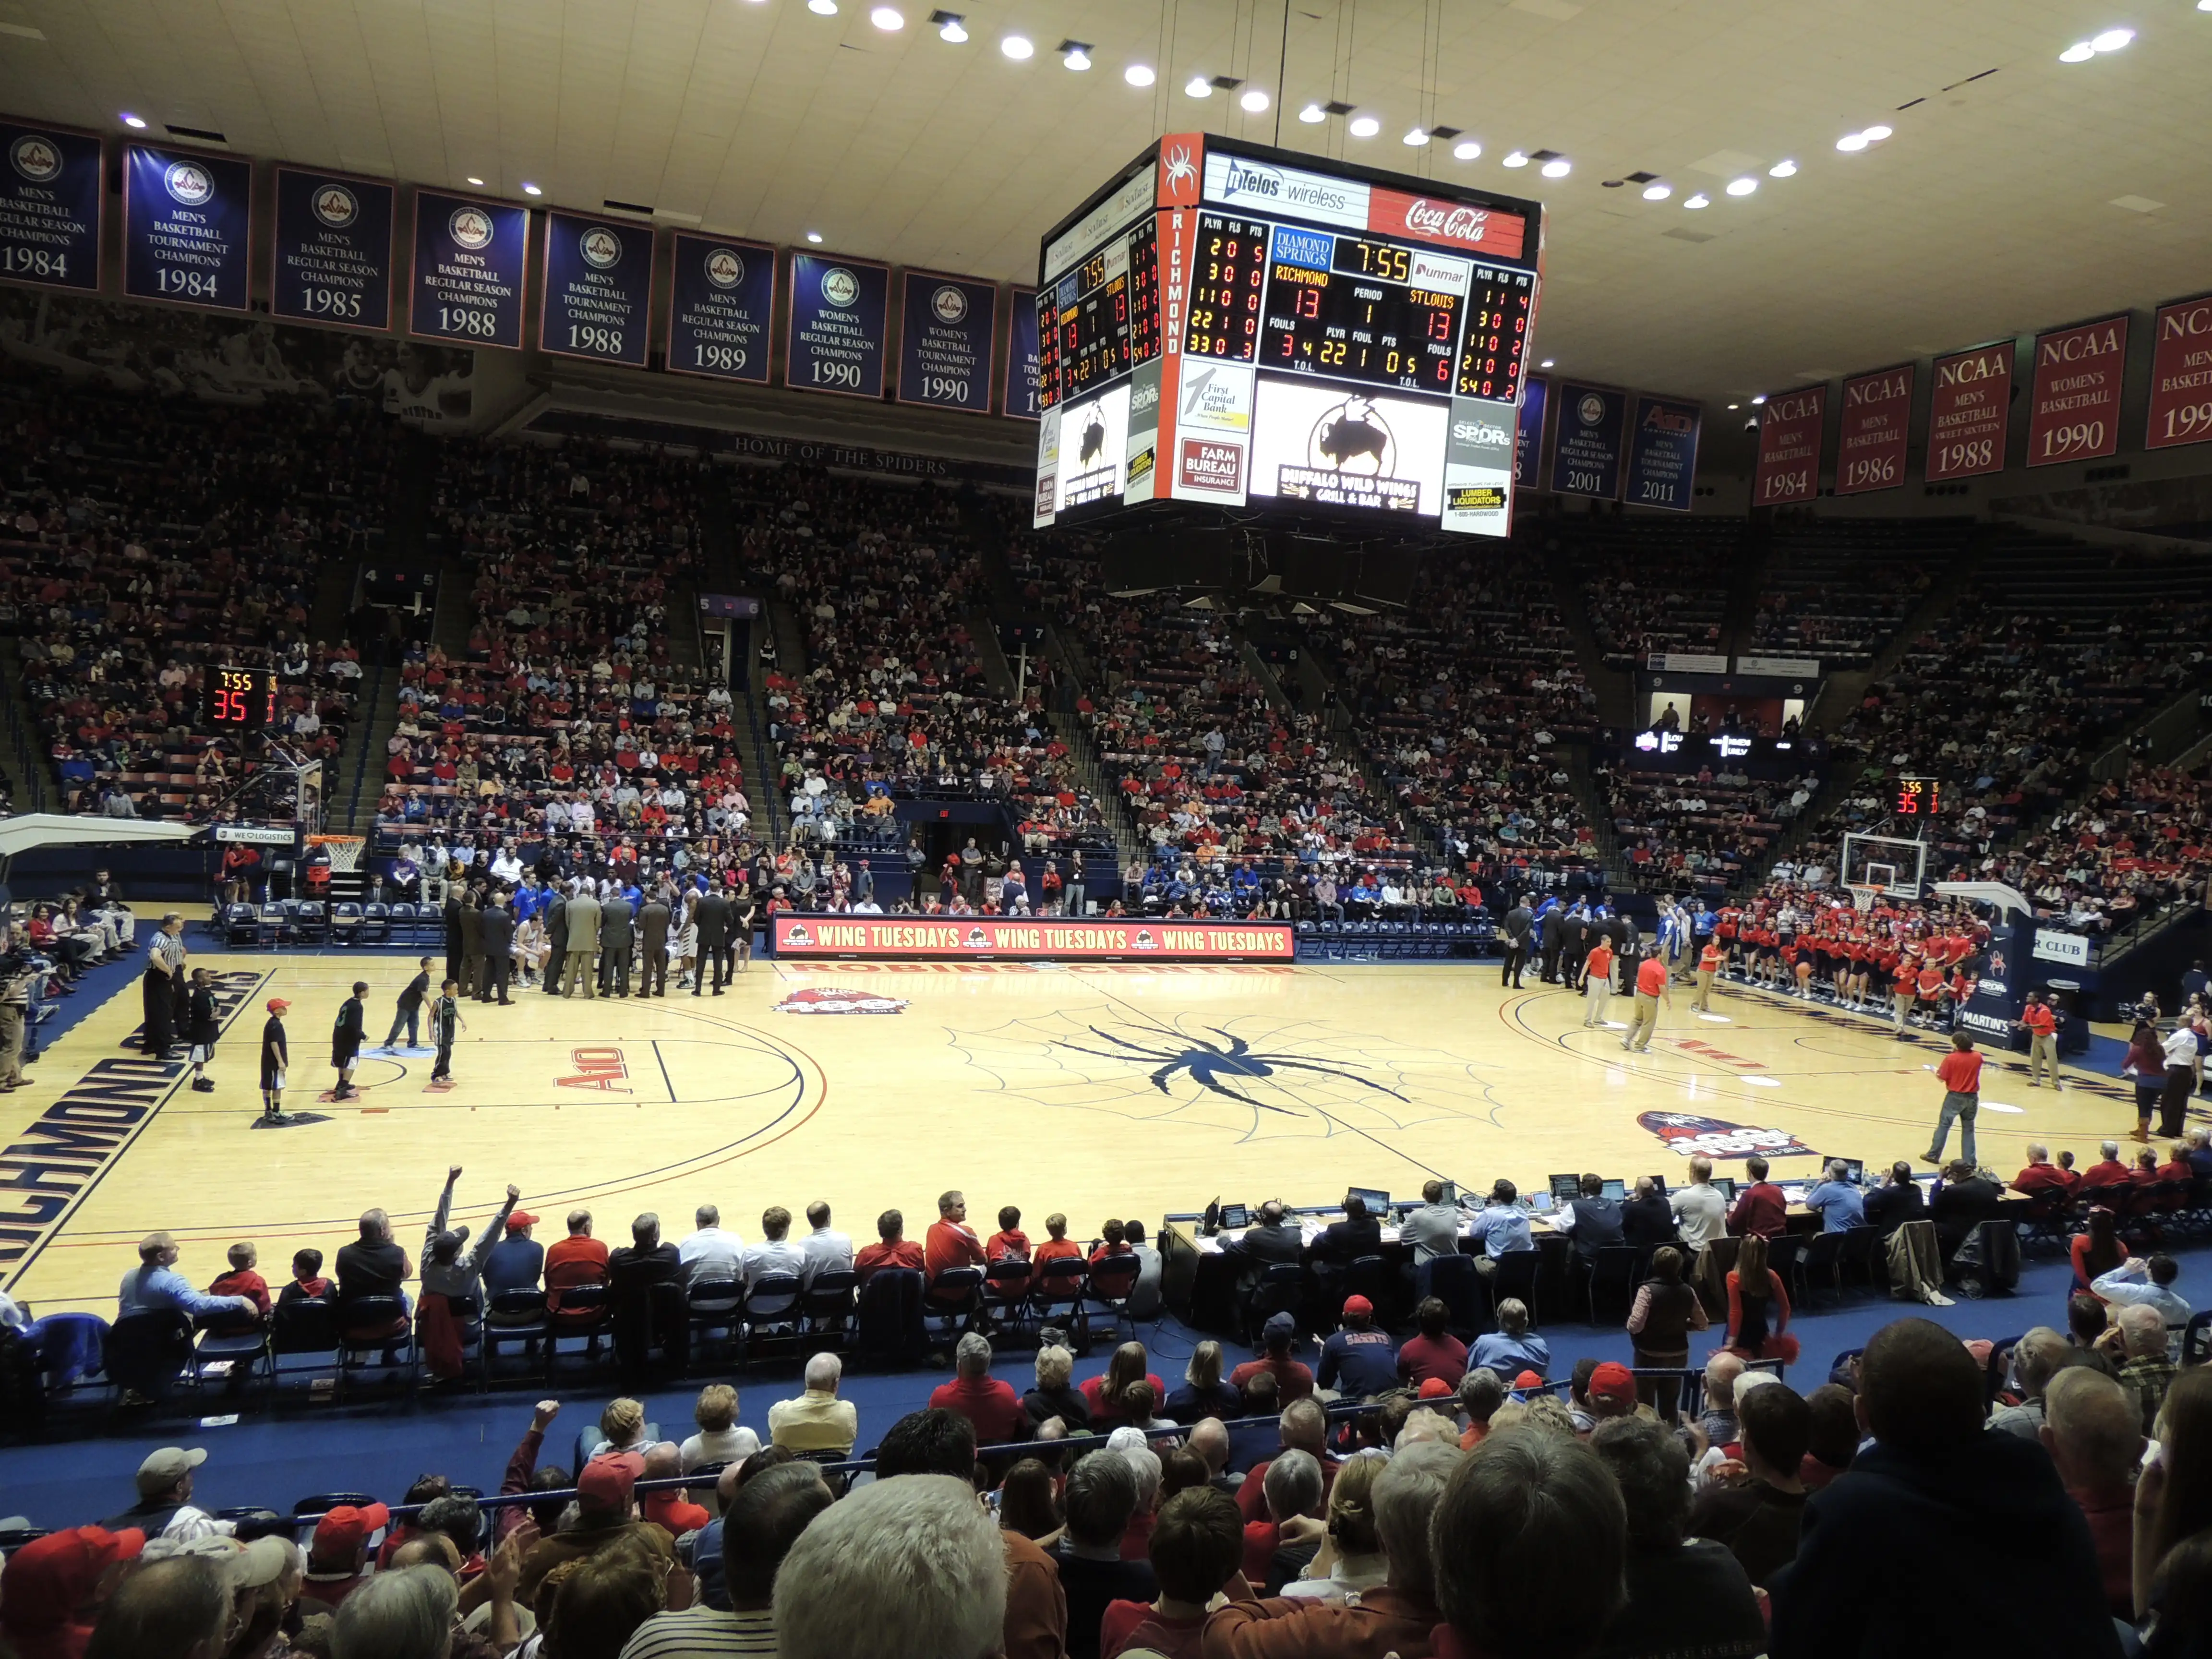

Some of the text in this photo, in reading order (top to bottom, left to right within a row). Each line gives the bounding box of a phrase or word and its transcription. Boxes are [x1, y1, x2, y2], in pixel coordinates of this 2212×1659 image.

[18, 186, 55, 201] MEN'S
[1287, 184, 1346, 210] wireless
[0, 198, 71, 217] BASKETBALL
[172, 210, 206, 224] MEN'S
[41, 218, 86, 234] SEASON
[154, 221, 223, 240] BASKETBALL
[1204, 217, 1262, 237] PLYR FLS PTS
[0, 227, 71, 245] CHAMPIONS
[147, 234, 229, 255] TOURNAMENT
[318, 232, 350, 245] MEN'S
[1276, 232, 1330, 252] DIAMOND
[2, 246, 67, 277] 1984
[154, 249, 221, 267] CHAMPIONS
[301, 243, 366, 262] BASKETBALL
[454, 252, 485, 267] MEN'S
[1275, 247, 1328, 266] SPRINGS
[1357, 243, 1407, 281] 7:55
[287, 255, 378, 276] REGULAR SEASON
[438, 264, 500, 282] BASKETBALL
[1415, 264, 1465, 283] Dunmar
[156, 267, 217, 298] 1984
[301, 271, 364, 289] CHAMPIONS
[424, 275, 512, 297] REGULAR SEASON
[584, 272, 614, 286] MEN'S
[1167, 214, 1183, 354] RICHMOND
[1276, 265, 1329, 288] RICHMOND
[1477, 269, 1528, 287] PLYR FLS PTS
[437, 291, 498, 308] CHAMPIONS
[569, 282, 627, 301] BASKETBALL
[709, 292, 737, 305] MEN'S
[1354, 287, 1383, 301] PERIOD
[302, 288, 361, 318] 1985
[563, 294, 633, 314] TOURNAMENT
[694, 303, 750, 320] BASKETBALL
[1297, 289, 1319, 318] 13
[439, 307, 496, 337] 1988
[568, 309, 625, 326] CHAMPIONS
[682, 314, 760, 334] REGULAR SEASON
[818, 309, 860, 324] WOMEN'S
[1269, 317, 1296, 331] FOULS
[811, 321, 864, 337] BASKETBALL
[928, 326, 968, 341] WOMEN'S
[1428, 312, 1451, 341] 13
[568, 324, 622, 355] 1988
[694, 329, 747, 344] CHAMPIONS
[800, 332, 875, 350] REGULAR SEASON
[922, 338, 972, 353] BASKETBALL
[1326, 326, 1397, 347] PLYR FOUL PTS
[811, 346, 863, 361] CHAMPIONS
[916, 349, 977, 365] TOURNAMENT
[1428, 343, 1452, 356] FOULS
[2041, 328, 2119, 367] NCAA
[694, 344, 746, 371] 1989
[811, 361, 861, 388] 1990
[922, 362, 971, 376] CHAMPIONS
[1937, 353, 2007, 388] NCAA
[921, 376, 968, 402] 1990
[1208, 383, 1229, 395] First
[1847, 375, 1907, 408] NCAA
[2050, 371, 2105, 393] WOMEN'S
[1201, 392, 1236, 405] Capital
[1954, 389, 1985, 407] MEN'S
[2040, 389, 2111, 414] BASKETBALL
[1203, 402, 1227, 414] Bank
[1765, 395, 1819, 424] NCAA
[1937, 406, 1998, 428] BASKETBALL
[1861, 414, 1888, 430] MEN'S
[1936, 421, 2000, 440] SWEET SIXTEEN
[1569, 438, 1606, 450] BASKETBALL
[1779, 432, 1803, 445] MEN'S
[1847, 429, 1900, 449] BASKETBALL
[2042, 421, 2104, 457] 1990
[734, 437, 946, 475] HOME OF THE SPIDERS
[1202, 446, 1236, 462] FARM
[1561, 446, 1614, 460] REGULAR SEASON
[1765, 445, 1813, 463] BASKETBALL
[1938, 439, 1992, 472] 1988
[1186, 458, 1236, 475] BUREAU
[1567, 457, 1605, 469] CHAMPIONS
[1846, 455, 1896, 486] 1986
[1194, 474, 1235, 487] INSURANCE
[1280, 468, 1417, 498] BUFFALO WILD WINGS
[1567, 470, 1601, 492] 2001
[1764, 469, 1807, 498] 1984
[1316, 488, 1345, 503] GRILL
[1358, 493, 1381, 507] BAR
[1461, 489, 1492, 497] LUMBER
[1640, 481, 1675, 502] 2011
[221, 672, 252, 691] 7:55
[1653, 677, 1803, 694] 9 9
[214, 690, 246, 721] 35
[1900, 781, 1922, 793] 7:55
[1897, 793, 1917, 813] 35
[255, 832, 292, 841] LOGISTICS
[817, 926, 1285, 951] WING TUESDAYS WING TUESDAYS WING TUESDAYS
[2046, 941, 2080, 955] CLUB
[790, 963, 1307, 975] ROBINS CENTER
[1962, 1011, 2009, 1032] MARTIN'S
